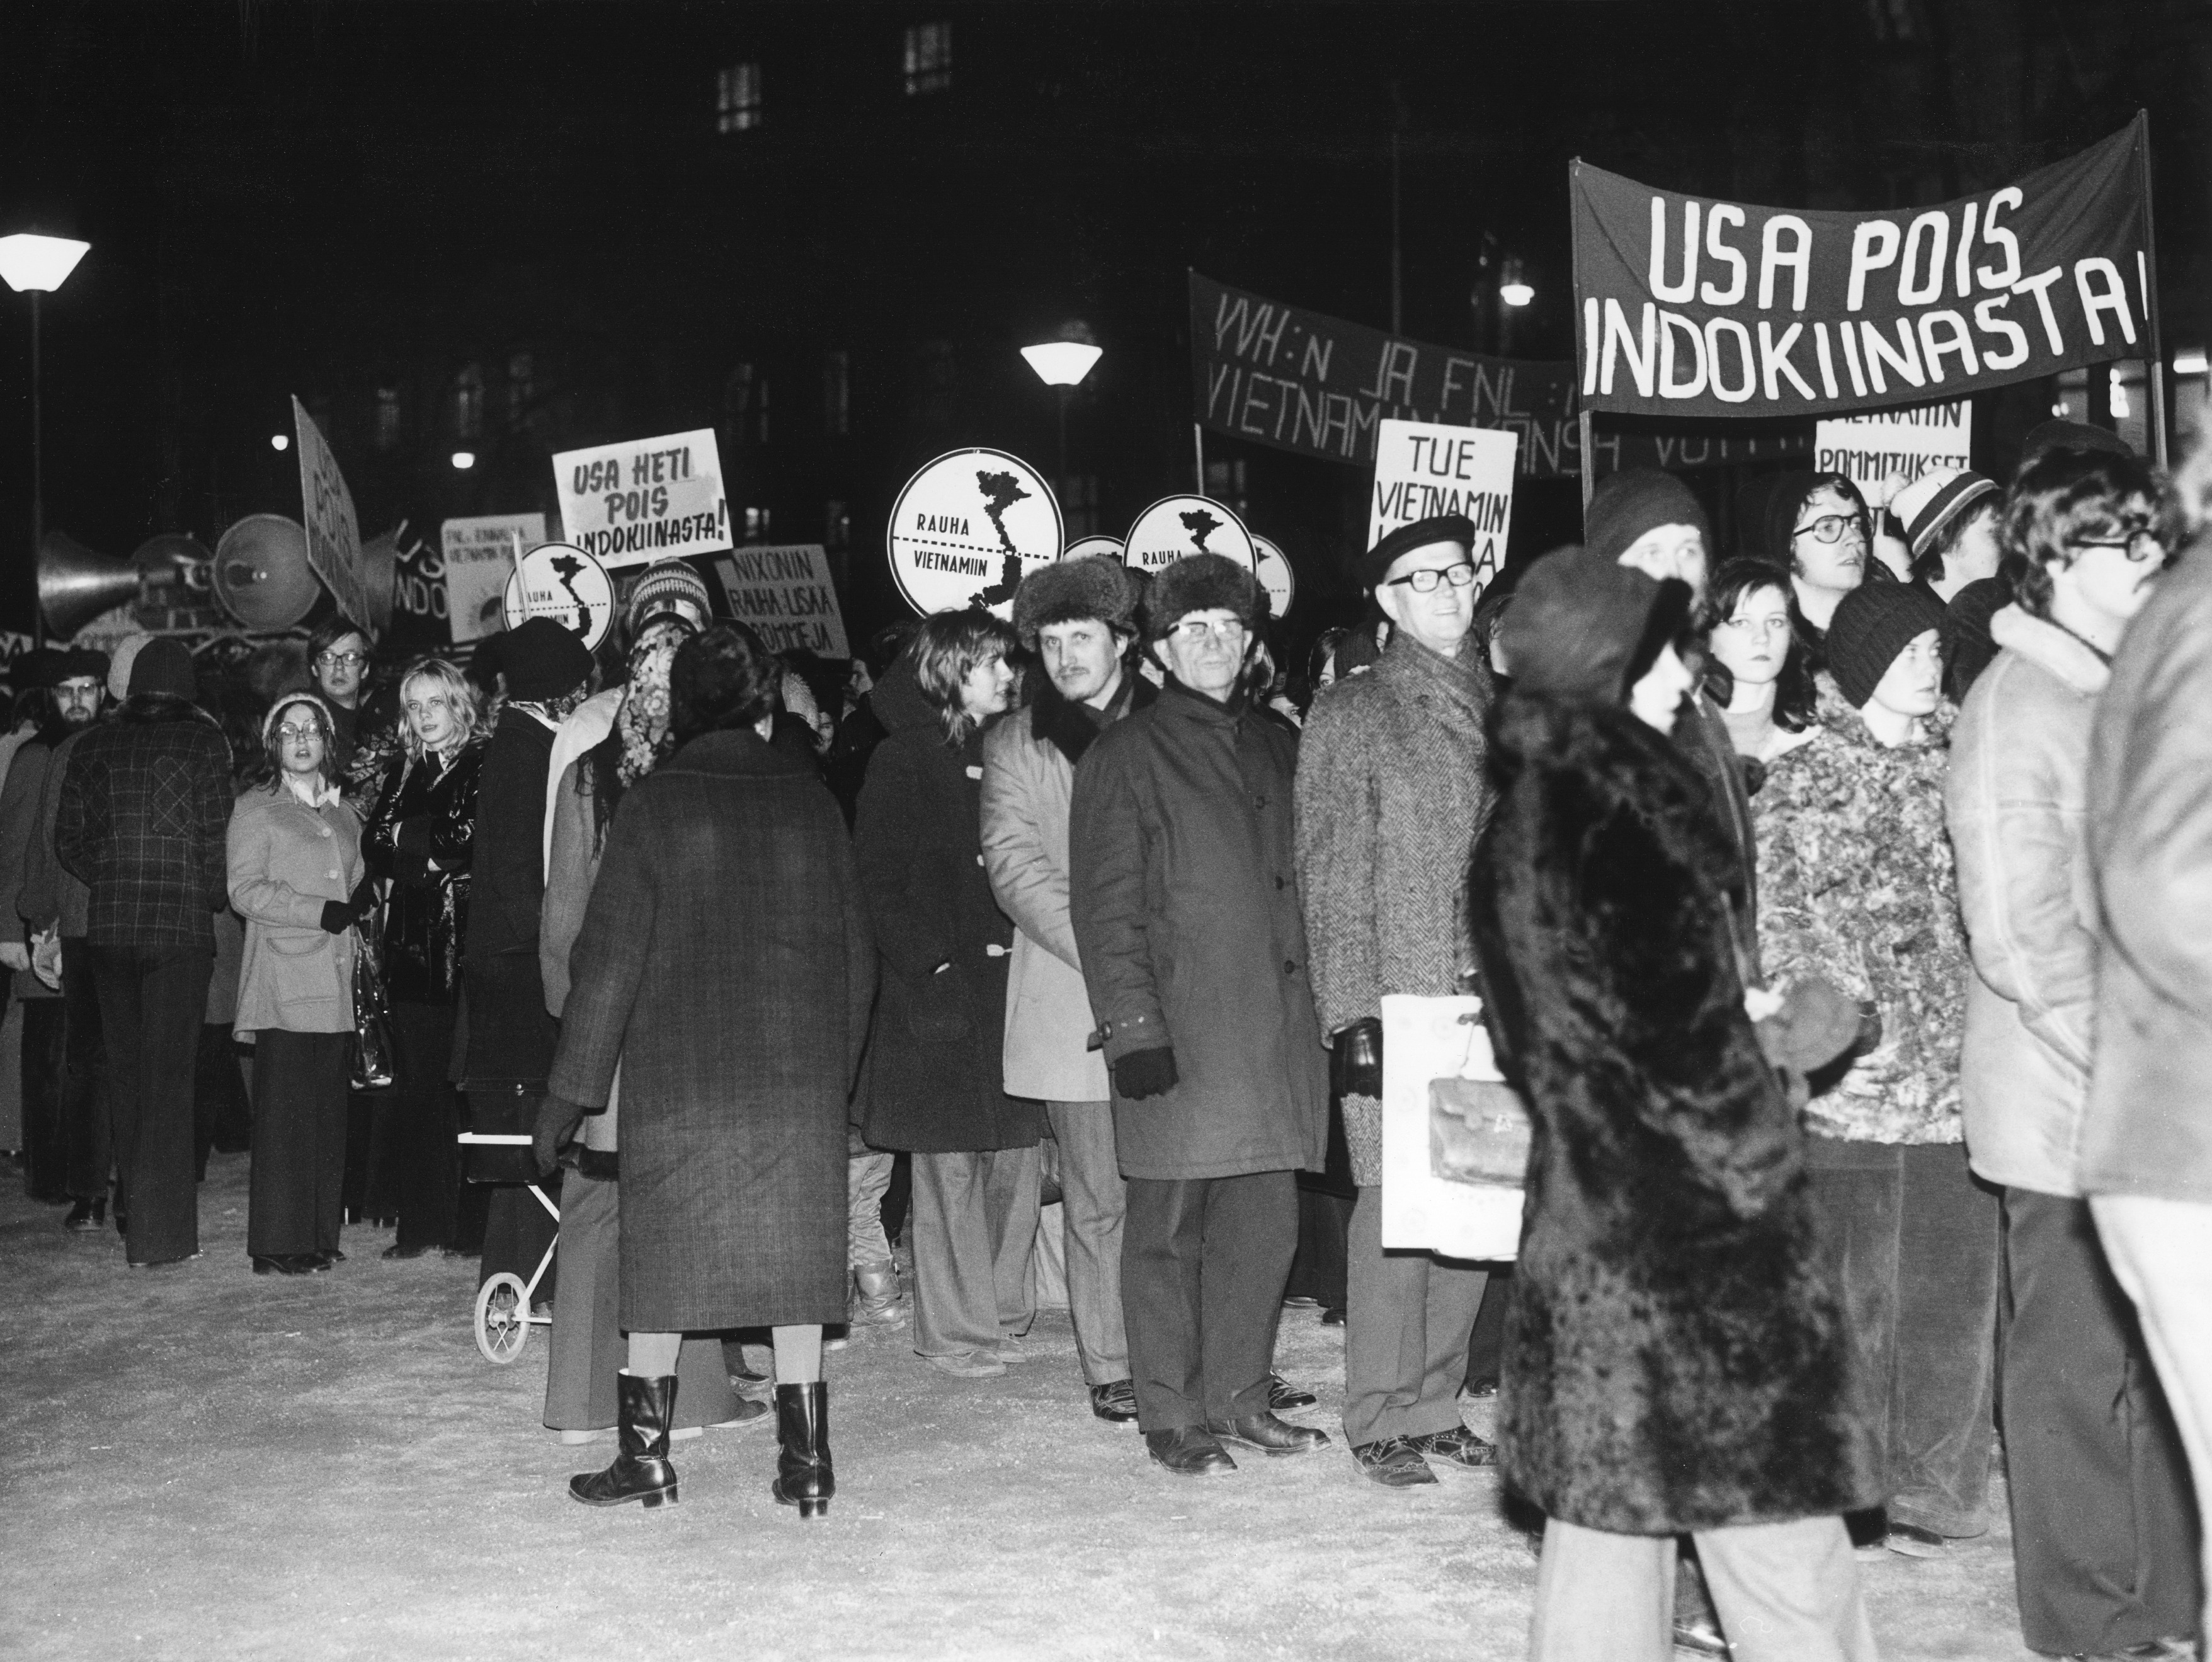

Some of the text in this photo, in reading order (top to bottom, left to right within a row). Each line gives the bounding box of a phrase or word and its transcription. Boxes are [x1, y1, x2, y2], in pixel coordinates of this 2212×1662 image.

[1649, 186, 2023, 312] USA POIS
[1360, 341, 1418, 408] JA
[1207, 362, 1440, 462] VIETNAM
[574, 447, 690, 495] USA HETI
[1408, 435, 1475, 480] TUE
[605, 486, 669, 525] POIS
[916, 513, 969, 536] RAUHA
[1377, 480, 1508, 534] VIETNAMIN
[733, 551, 815, 582] NIXONIN
[914, 550, 988, 577] VIETNAMIIN
[1143, 550, 1182, 566] RAUHA
[528, 590, 552, 602] UHA
